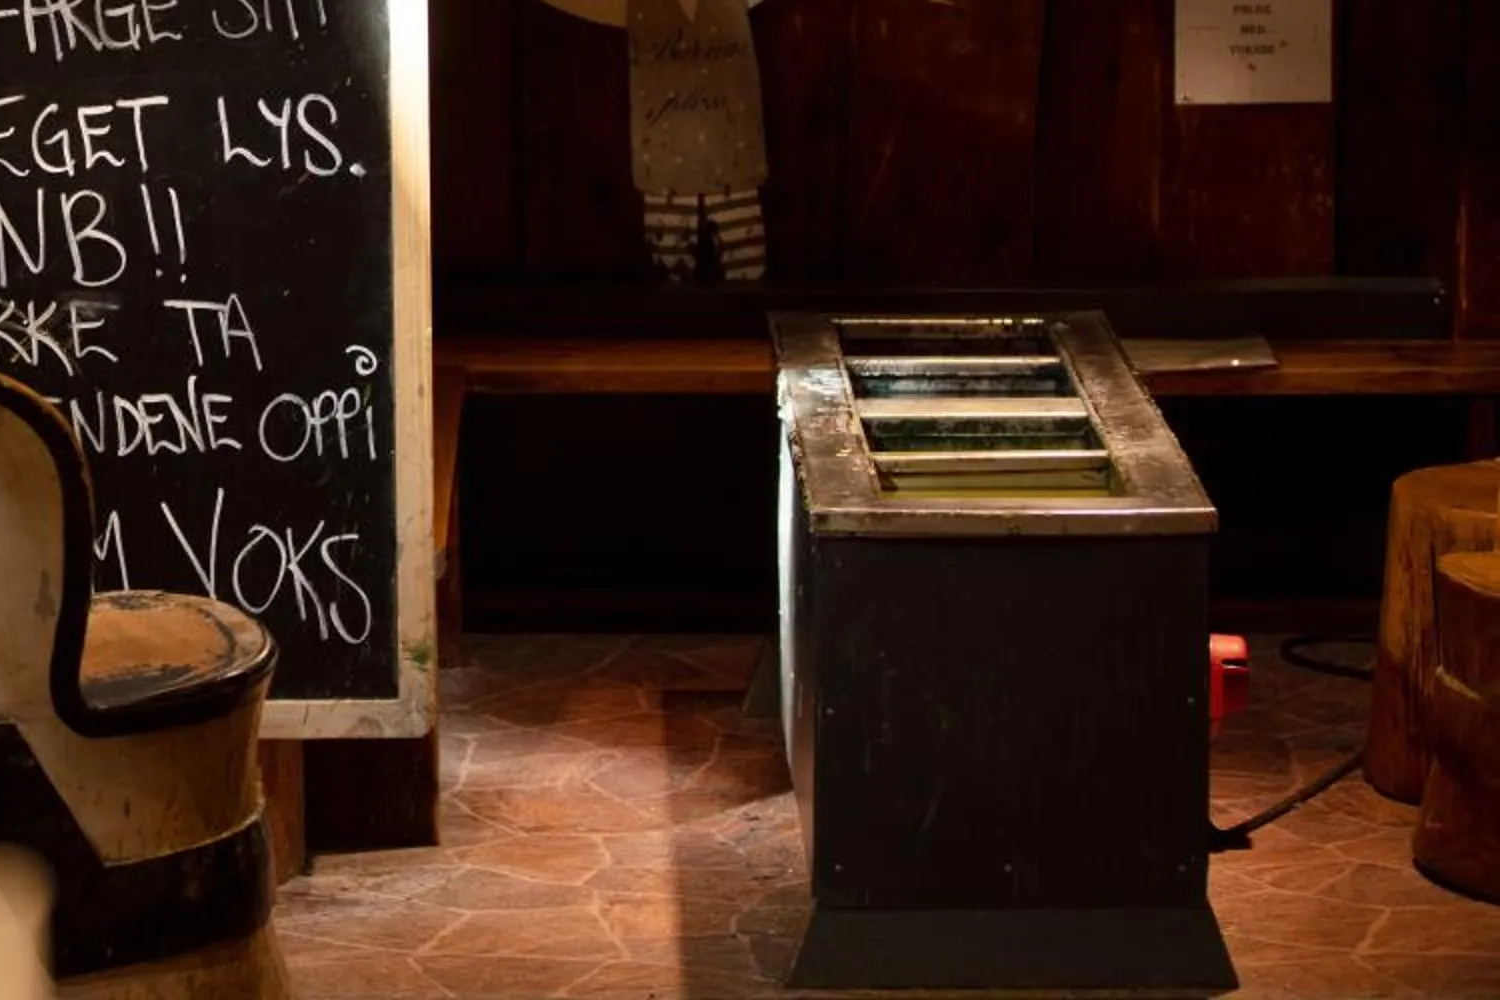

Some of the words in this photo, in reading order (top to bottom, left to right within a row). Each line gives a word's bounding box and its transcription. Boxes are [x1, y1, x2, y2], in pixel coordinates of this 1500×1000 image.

[217, 94, 367, 176] LYS.
[163, 294, 263, 372] TA
[41, 375, 243, 457] NDENE
[161, 488, 372, 645] VOKS
